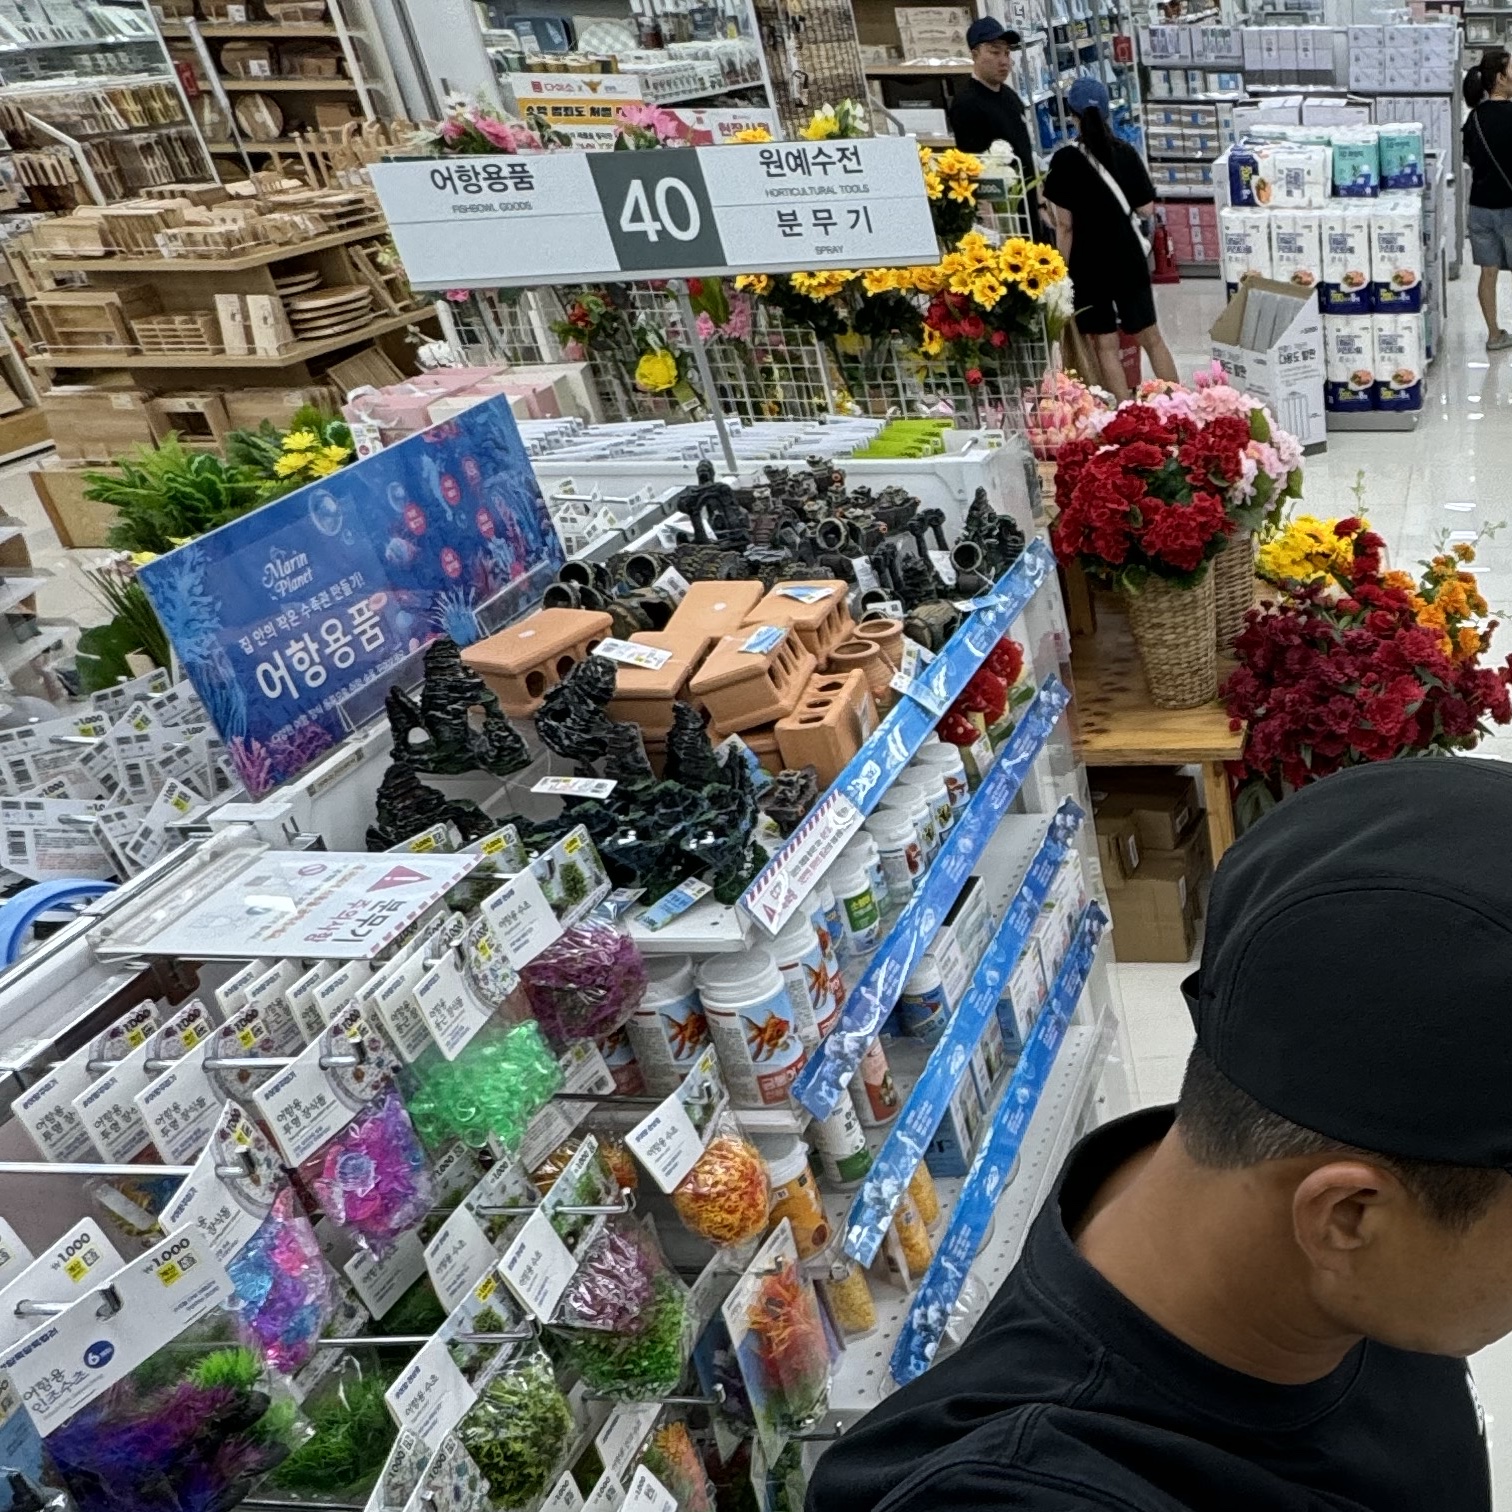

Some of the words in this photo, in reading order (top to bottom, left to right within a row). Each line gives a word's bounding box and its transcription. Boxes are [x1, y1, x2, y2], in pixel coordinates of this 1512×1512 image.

[429, 162, 535, 196] 어항용품
[758, 147, 865, 181] 원예수전
[840, 183, 870, 195] TOOLS
[619, 177, 701, 243] 40
[815, 244, 844, 255] SPRAY
[263, 551, 309, 590] Marin
[274, 567, 314, 601] Planet
[238, 635, 254, 656] 집
[253, 621, 278, 647] 안의
[277, 611, 301, 633] 작은
[300, 593, 332, 622] 수족관
[331, 572, 365, 604] 만들기!
[256, 599, 386, 702] 어항용품
[331, 899, 408, 943] 분무기
[142, 1237, 191, 1276] ₩1,000
[23, 1368, 66, 1402] 어항용
[31, 1370, 89, 1414] 인조수초
